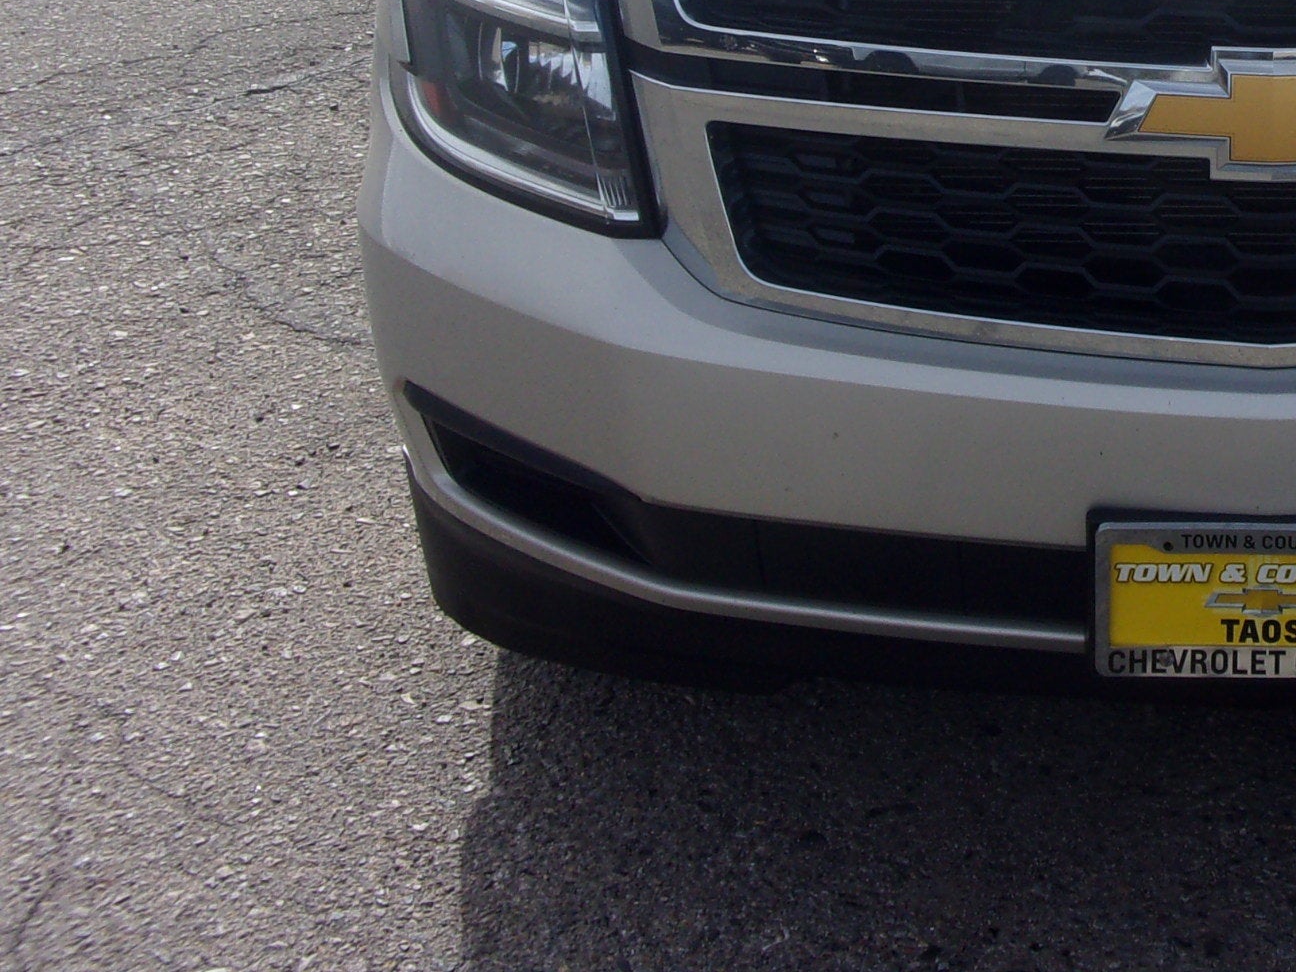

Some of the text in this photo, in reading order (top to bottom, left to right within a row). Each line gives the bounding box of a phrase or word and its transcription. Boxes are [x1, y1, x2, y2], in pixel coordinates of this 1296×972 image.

[1181, 534, 1239, 551] TOWN
[1243, 535, 1256, 550] &
[1114, 563, 1214, 585] TOWN
[1219, 563, 1248, 584] &
[1108, 650, 1286, 676] CHEVROLET
